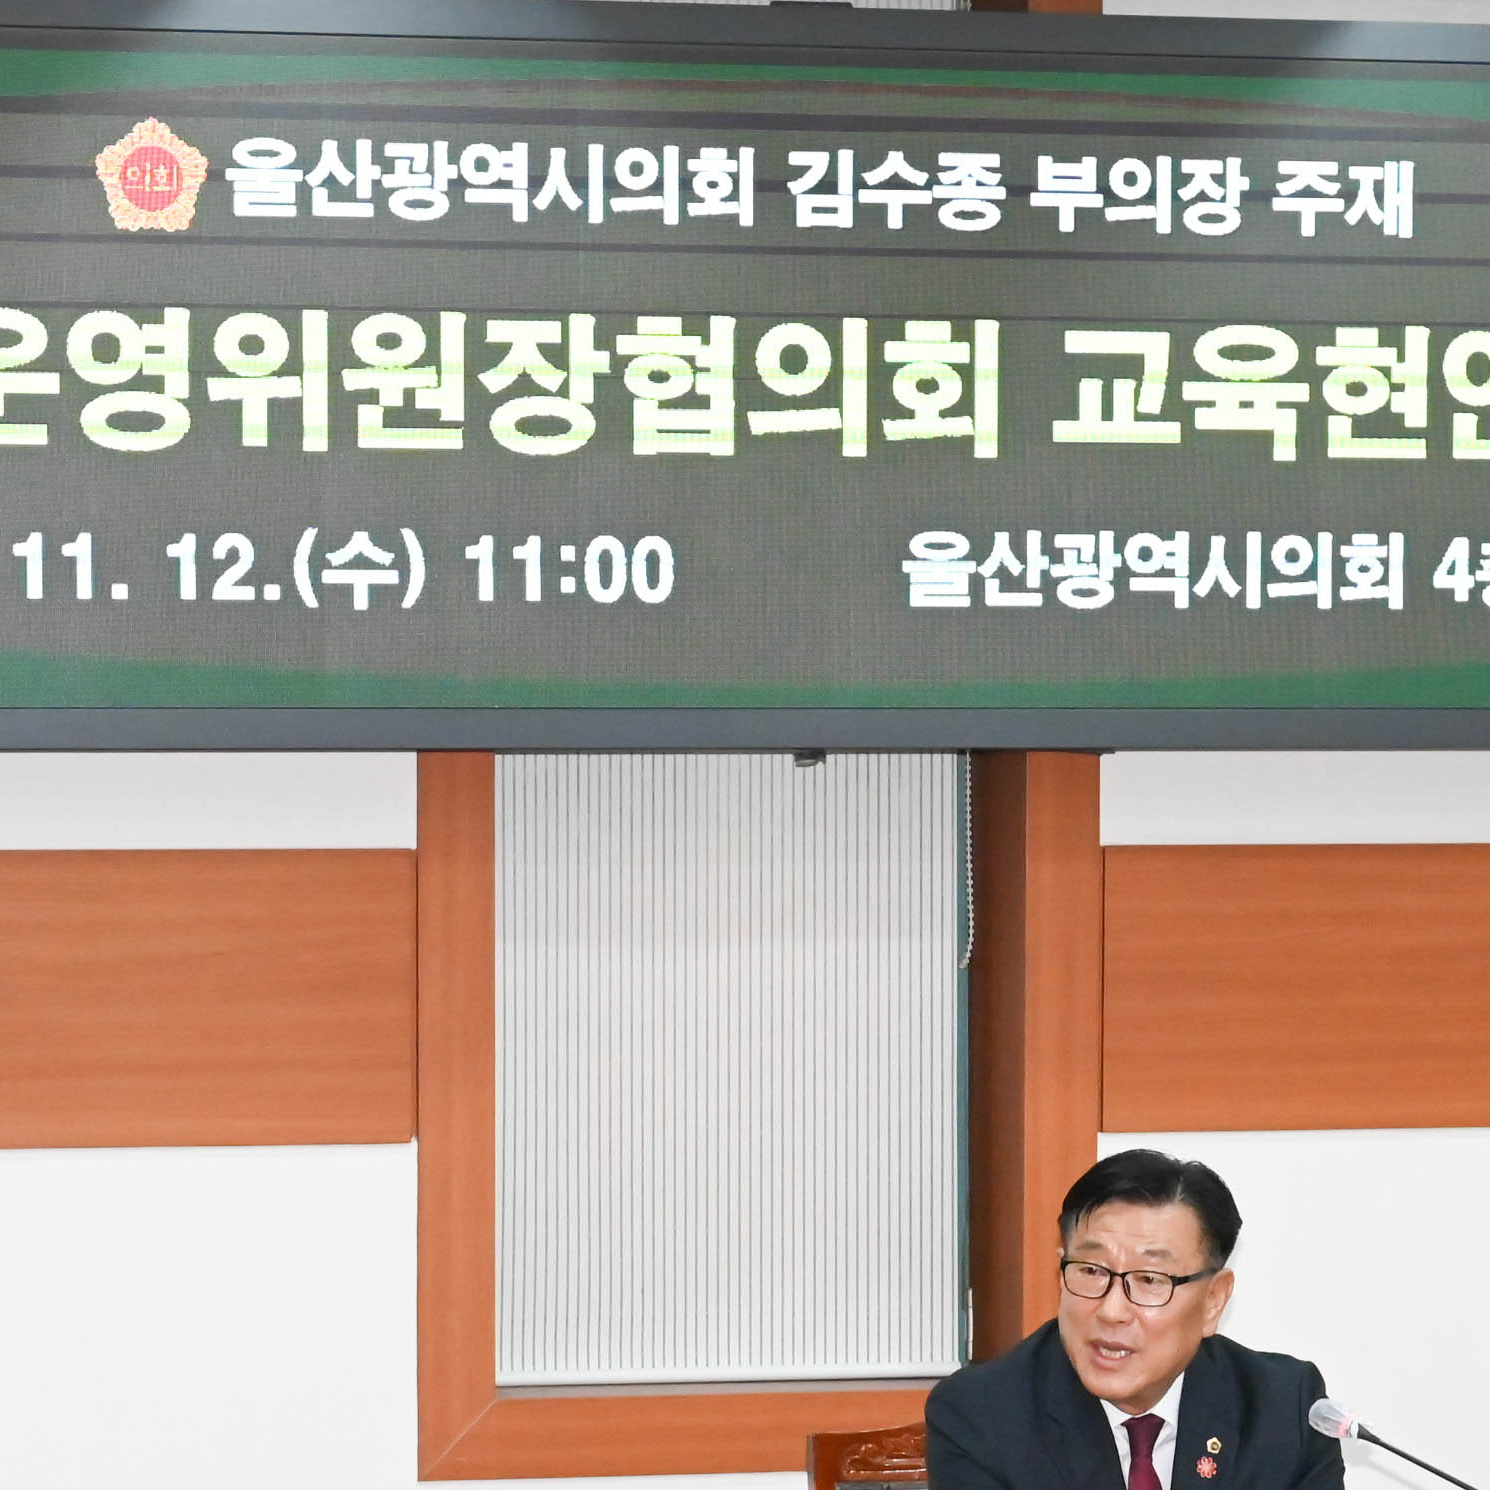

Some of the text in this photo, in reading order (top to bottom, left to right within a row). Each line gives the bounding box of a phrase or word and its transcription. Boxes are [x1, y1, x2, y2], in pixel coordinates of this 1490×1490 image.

[225, 138, 1414, 238] 울산광역시의회 김수종 부의장 주재
[13, 532, 128, 600] 11.
[167, 528, 425, 610] 12.(수)
[466, 535, 674, 603] 11:00
[902, 530, 1404, 609] 울산광역시의회
